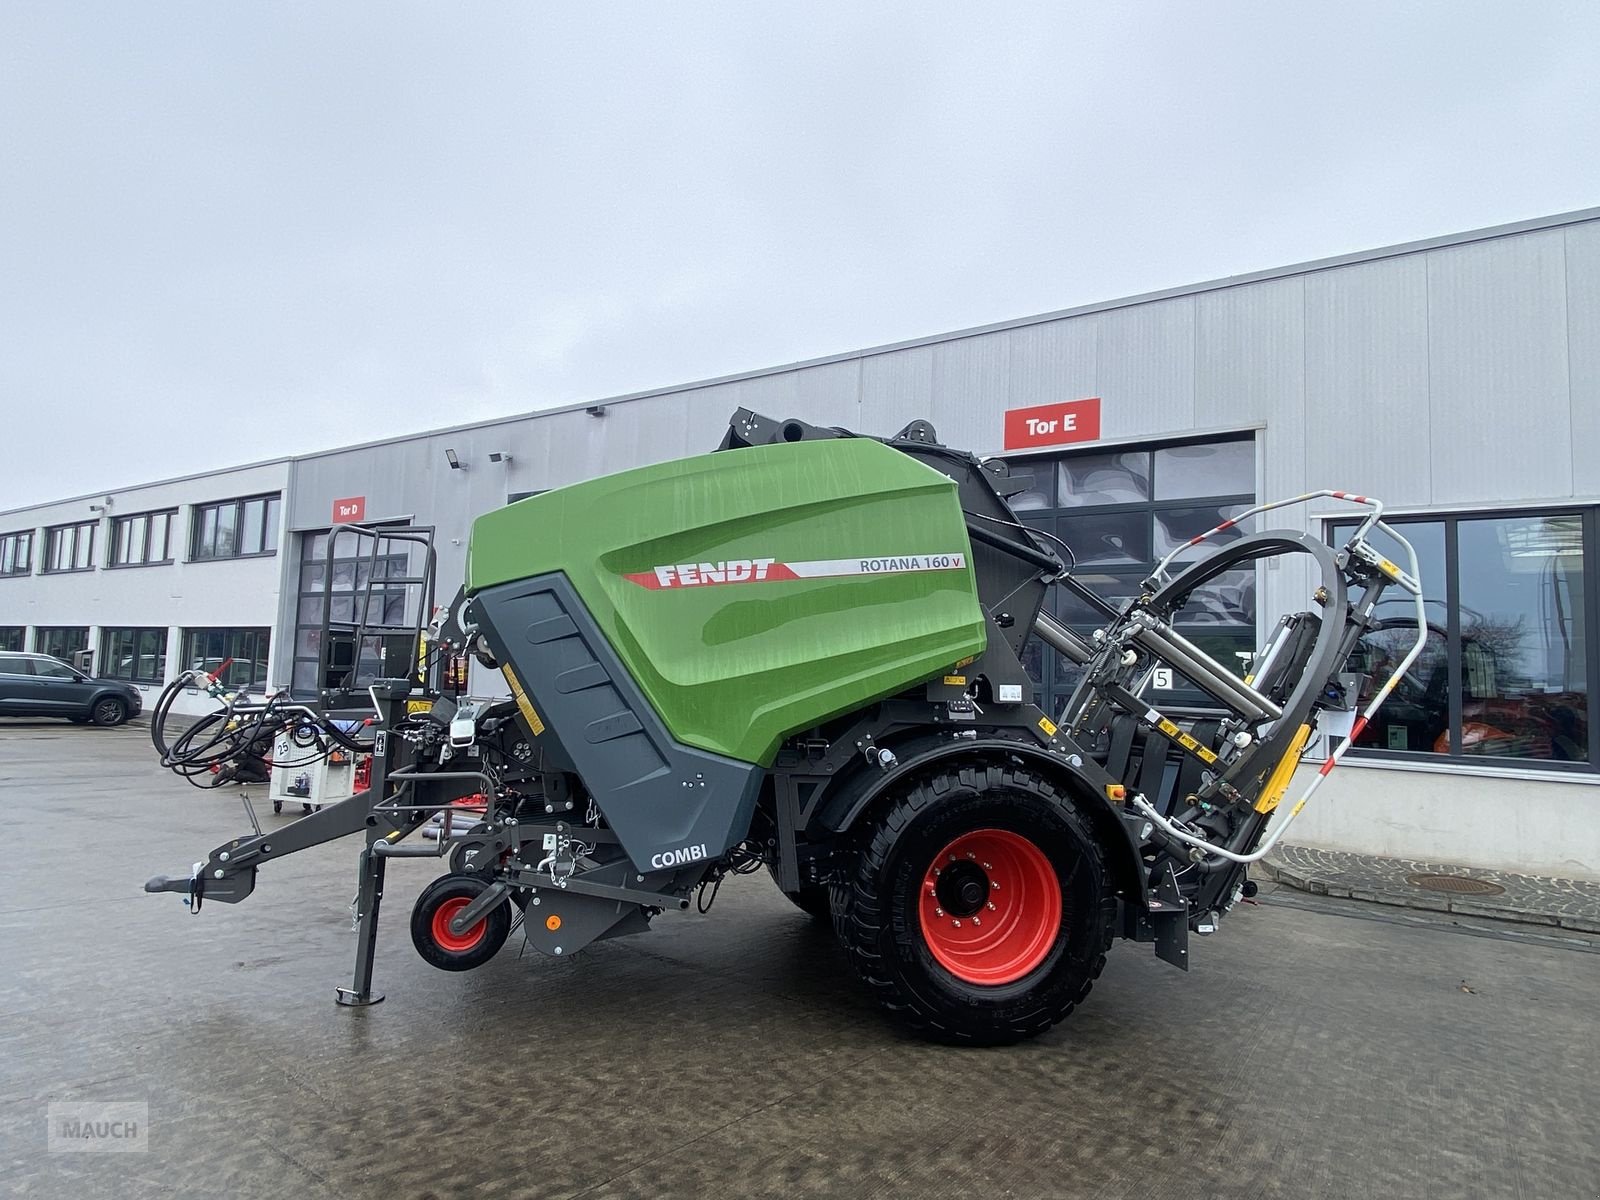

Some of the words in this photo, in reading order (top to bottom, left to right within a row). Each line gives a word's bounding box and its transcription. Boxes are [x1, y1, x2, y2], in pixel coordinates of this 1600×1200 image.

[1026, 418, 1058, 436] Tor
[1063, 413, 1077, 431] E
[340, 505, 351, 516] Tor
[351, 504, 358, 515] D
[860, 558, 921, 572] ROTANA
[924, 556, 950, 569] 160
[653, 558, 775, 587] FENDT
[1156, 671, 1168, 687] 5
[277, 741, 289, 756] 25
[651, 843, 708, 869] COMBI
